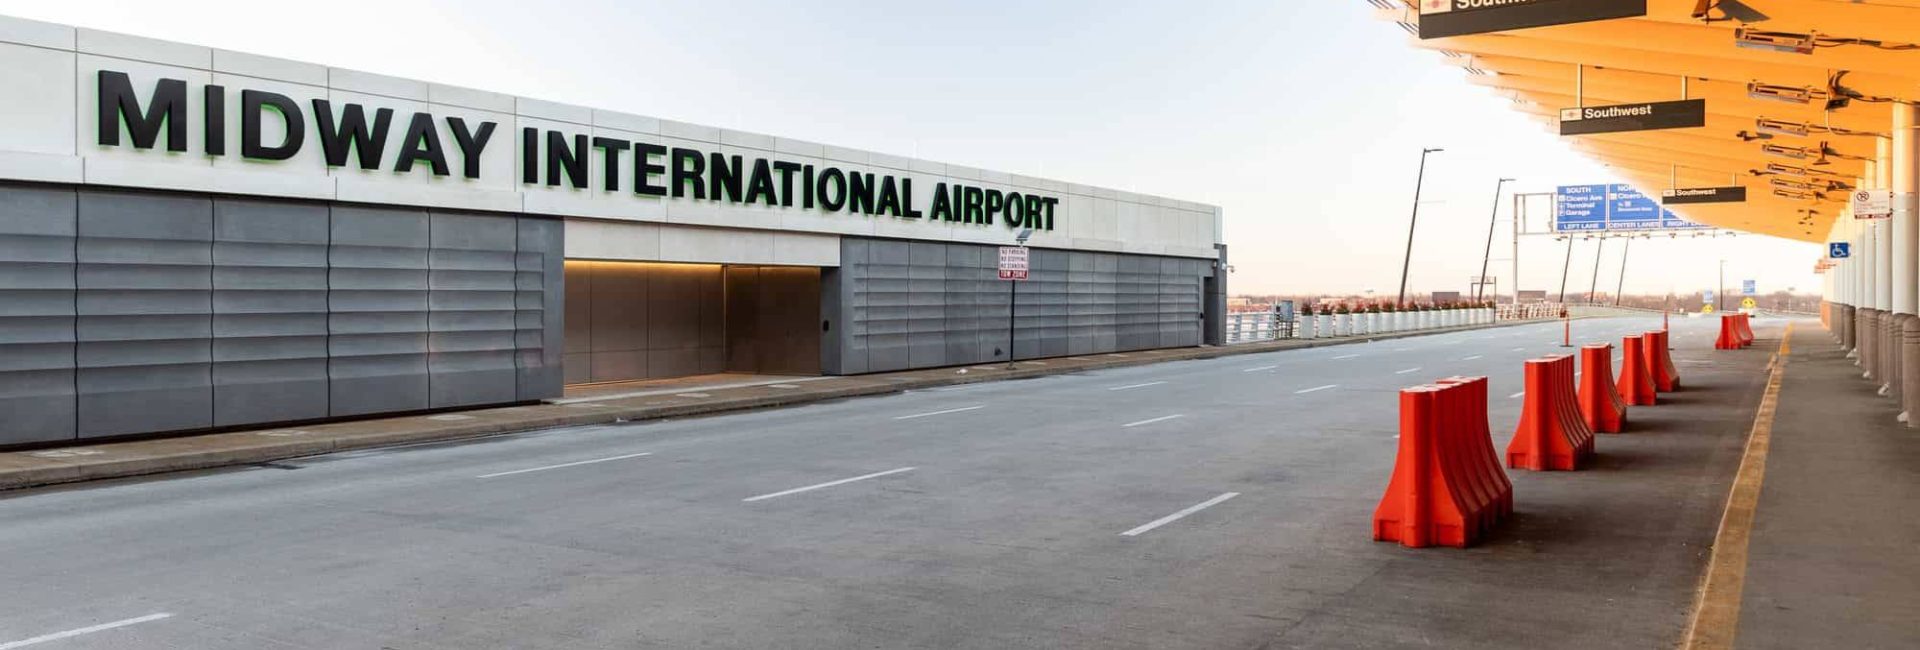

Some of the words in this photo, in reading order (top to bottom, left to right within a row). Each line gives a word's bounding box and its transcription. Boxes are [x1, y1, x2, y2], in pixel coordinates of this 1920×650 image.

[1584, 104, 1652, 119] Southwest
[98, 70, 498, 179] MIDWAY
[522, 127, 922, 218] INTERNATIONAL
[929, 182, 1059, 231] AIRPORT
[1676, 188, 1717, 197] Southwest
[1565, 209, 1591, 217] Garage
[1608, 222, 1637, 230] CENTER
